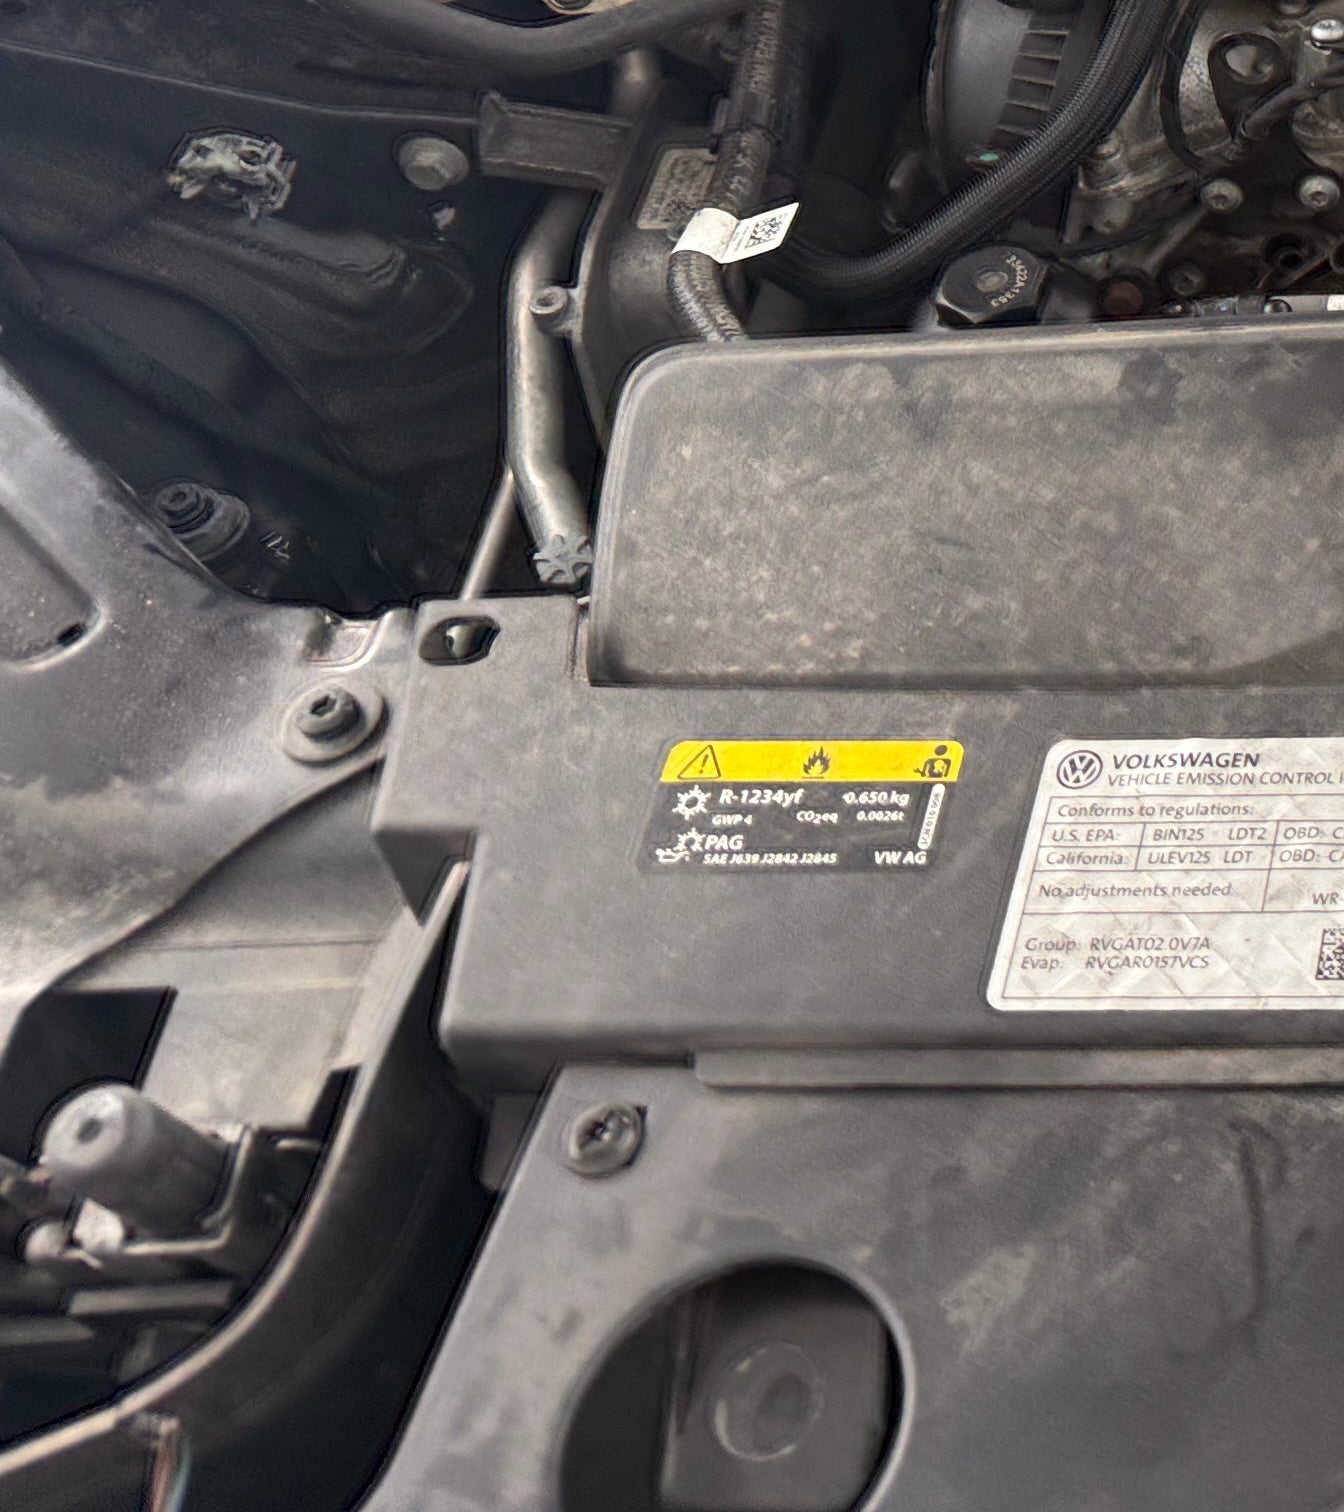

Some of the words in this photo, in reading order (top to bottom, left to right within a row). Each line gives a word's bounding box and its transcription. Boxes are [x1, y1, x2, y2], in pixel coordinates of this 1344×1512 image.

[1113, 752, 1260, 770] VOLKSWAGEN
[1108, 773, 1171, 787] VEHICLE
[1176, 772, 1254, 785] EMISSION
[1259, 771, 1334, 785] CONTROL
[720, 788, 804, 808] R-1234yf
[890, 790, 910, 807] kg
[1058, 804, 1135, 818] Conforms
[1139, 802, 1155, 817] to
[712, 814, 743, 825] GWP
[744, 814, 752, 825] 4
[1052, 829, 1080, 843] U.S.
[1152, 828, 1205, 841] BIN125
[1228, 827, 1267, 840] LDT2
[704, 835, 744, 849] PAG
[703, 853, 728, 864] SAE
[874, 851, 902, 864] VW
[902, 851, 927, 864] AG
[1046, 851, 1129, 866] California:
[1148, 850, 1211, 865] ULEV125
[1223, 850, 1254, 864] LDT
[1038, 885, 1062, 898] No
[1064, 883, 1168, 900] adjustments
[1171, 882, 1232, 897] needed
